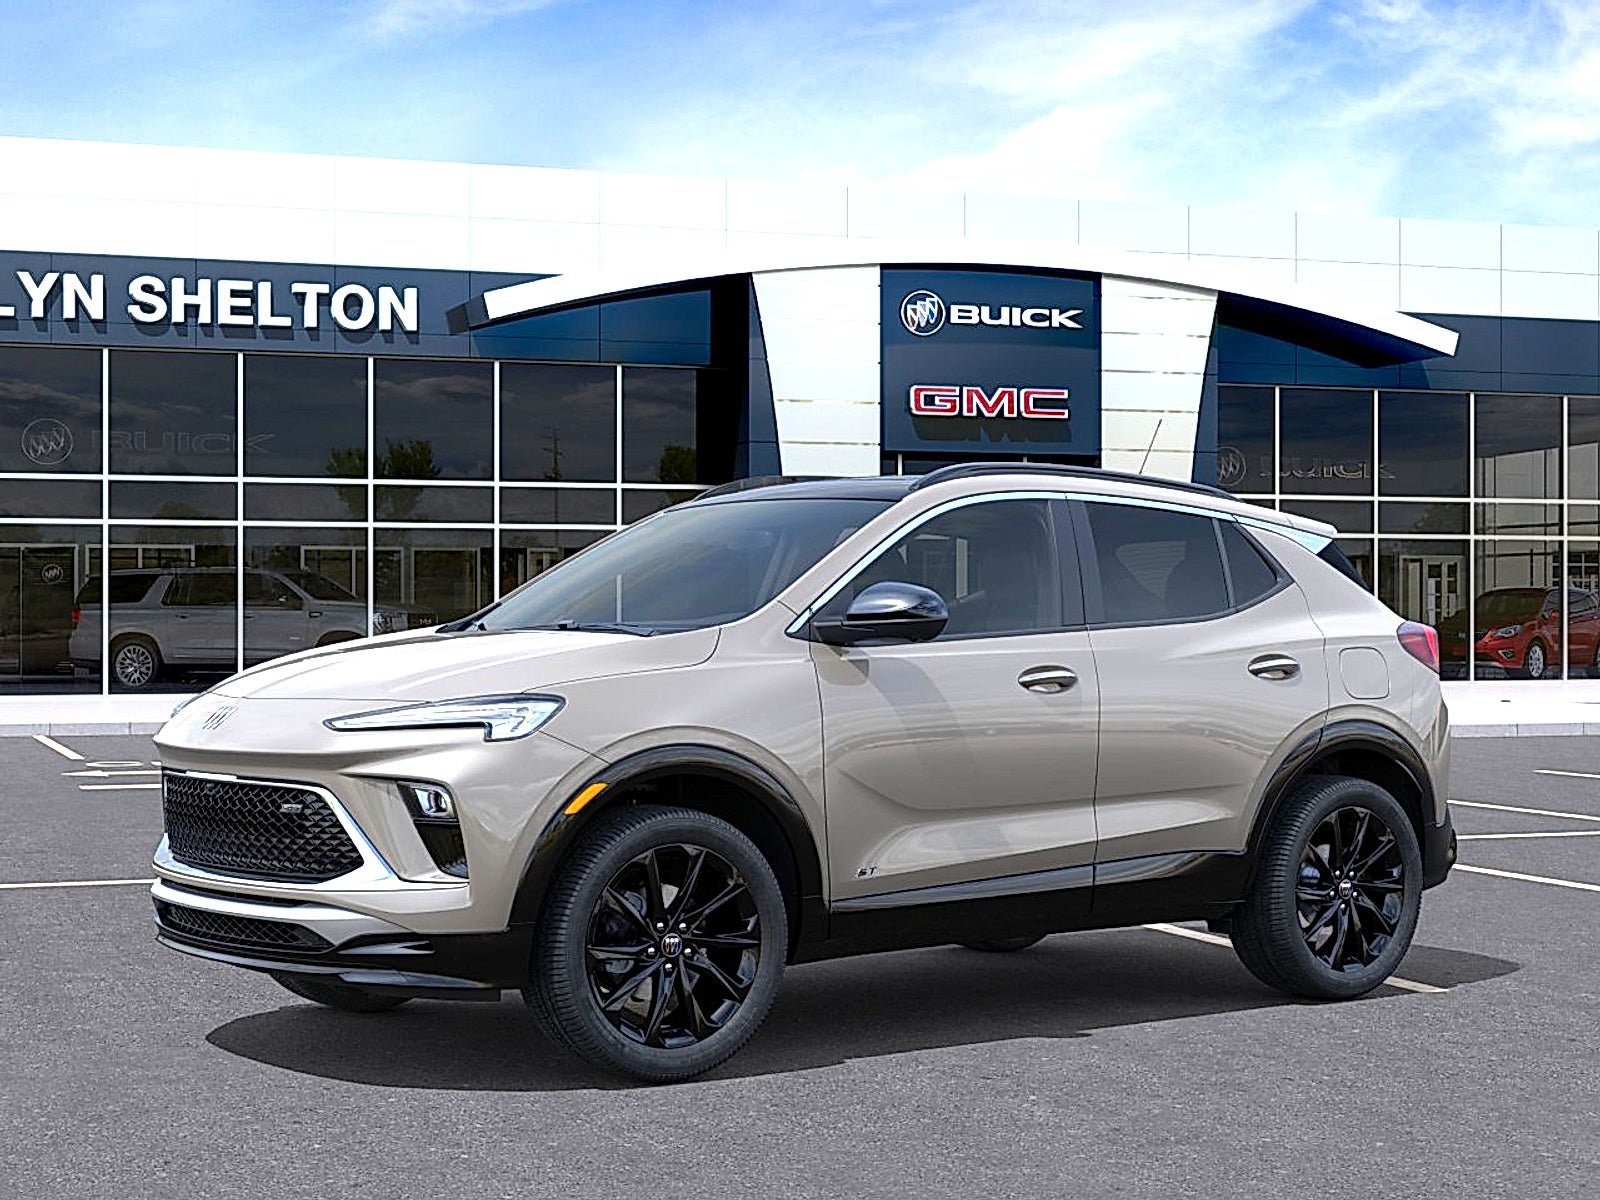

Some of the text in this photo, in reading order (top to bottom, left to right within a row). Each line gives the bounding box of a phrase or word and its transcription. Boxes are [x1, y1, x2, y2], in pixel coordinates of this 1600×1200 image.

[127, 275, 418, 331] SHELTON
[949, 304, 1083, 329] BUICK
[909, 385, 1068, 419] GMC
